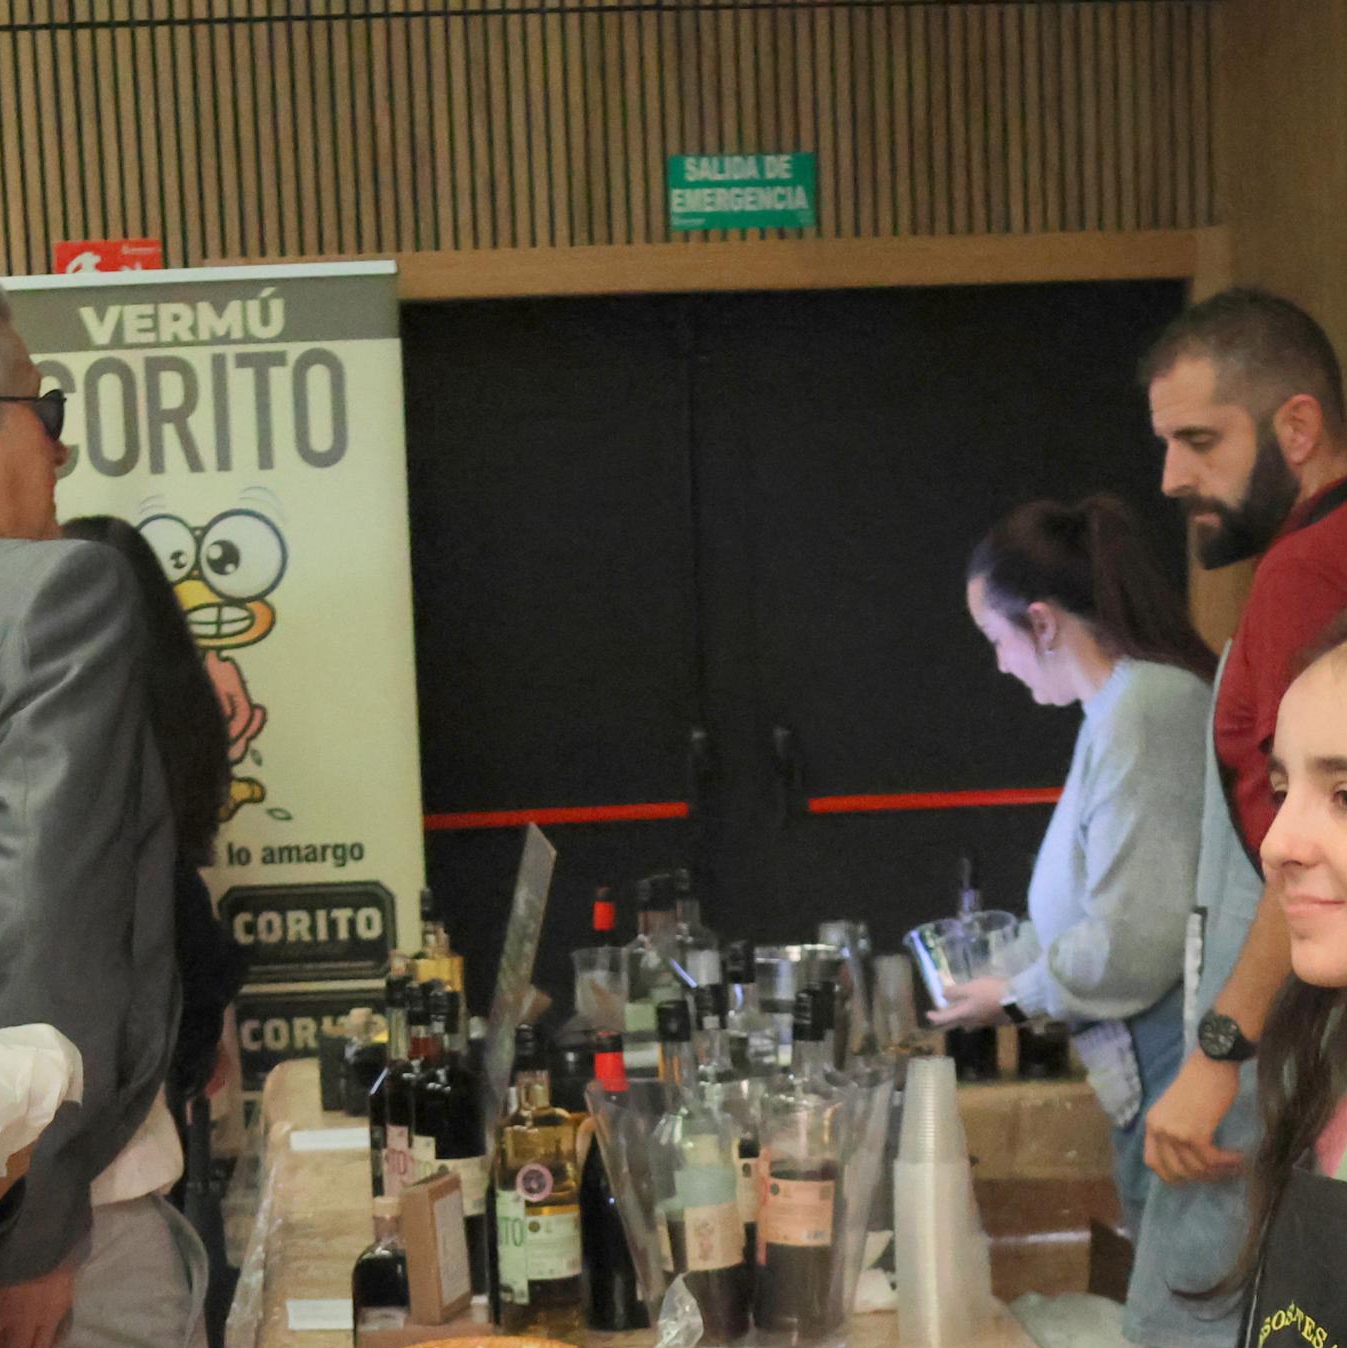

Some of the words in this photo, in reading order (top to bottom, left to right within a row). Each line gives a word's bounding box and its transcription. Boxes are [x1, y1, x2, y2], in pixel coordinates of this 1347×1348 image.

[684, 156, 760, 182] SALIDA
[764, 154, 793, 179] DE
[671, 185, 809, 213] EMERGENCIA
[79, 287, 286, 346] VERMÚ
[261, 842, 365, 867] amargo
[232, 906, 384, 945] CORITO
[240, 1013, 390, 1051] COR
